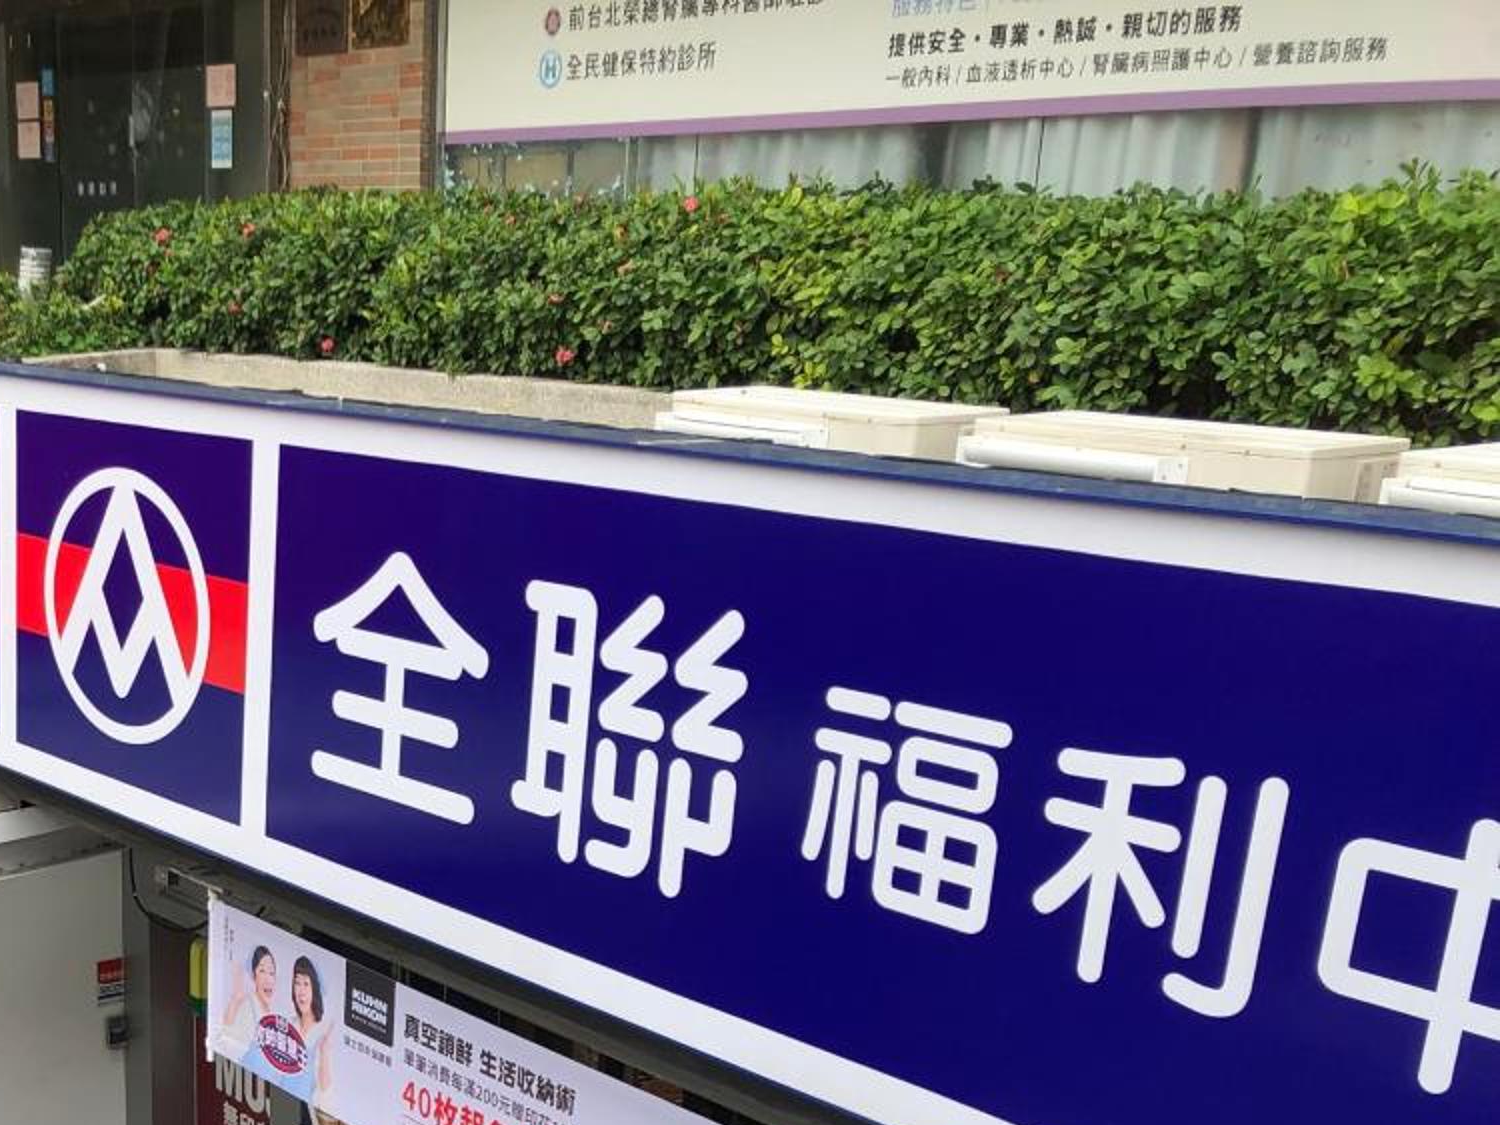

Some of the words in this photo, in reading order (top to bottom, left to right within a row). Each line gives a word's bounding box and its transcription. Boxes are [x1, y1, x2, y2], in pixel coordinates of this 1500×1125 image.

[566, 41, 717, 80] 全民健保特約診所
[215, 1056, 271, 1117] MU
